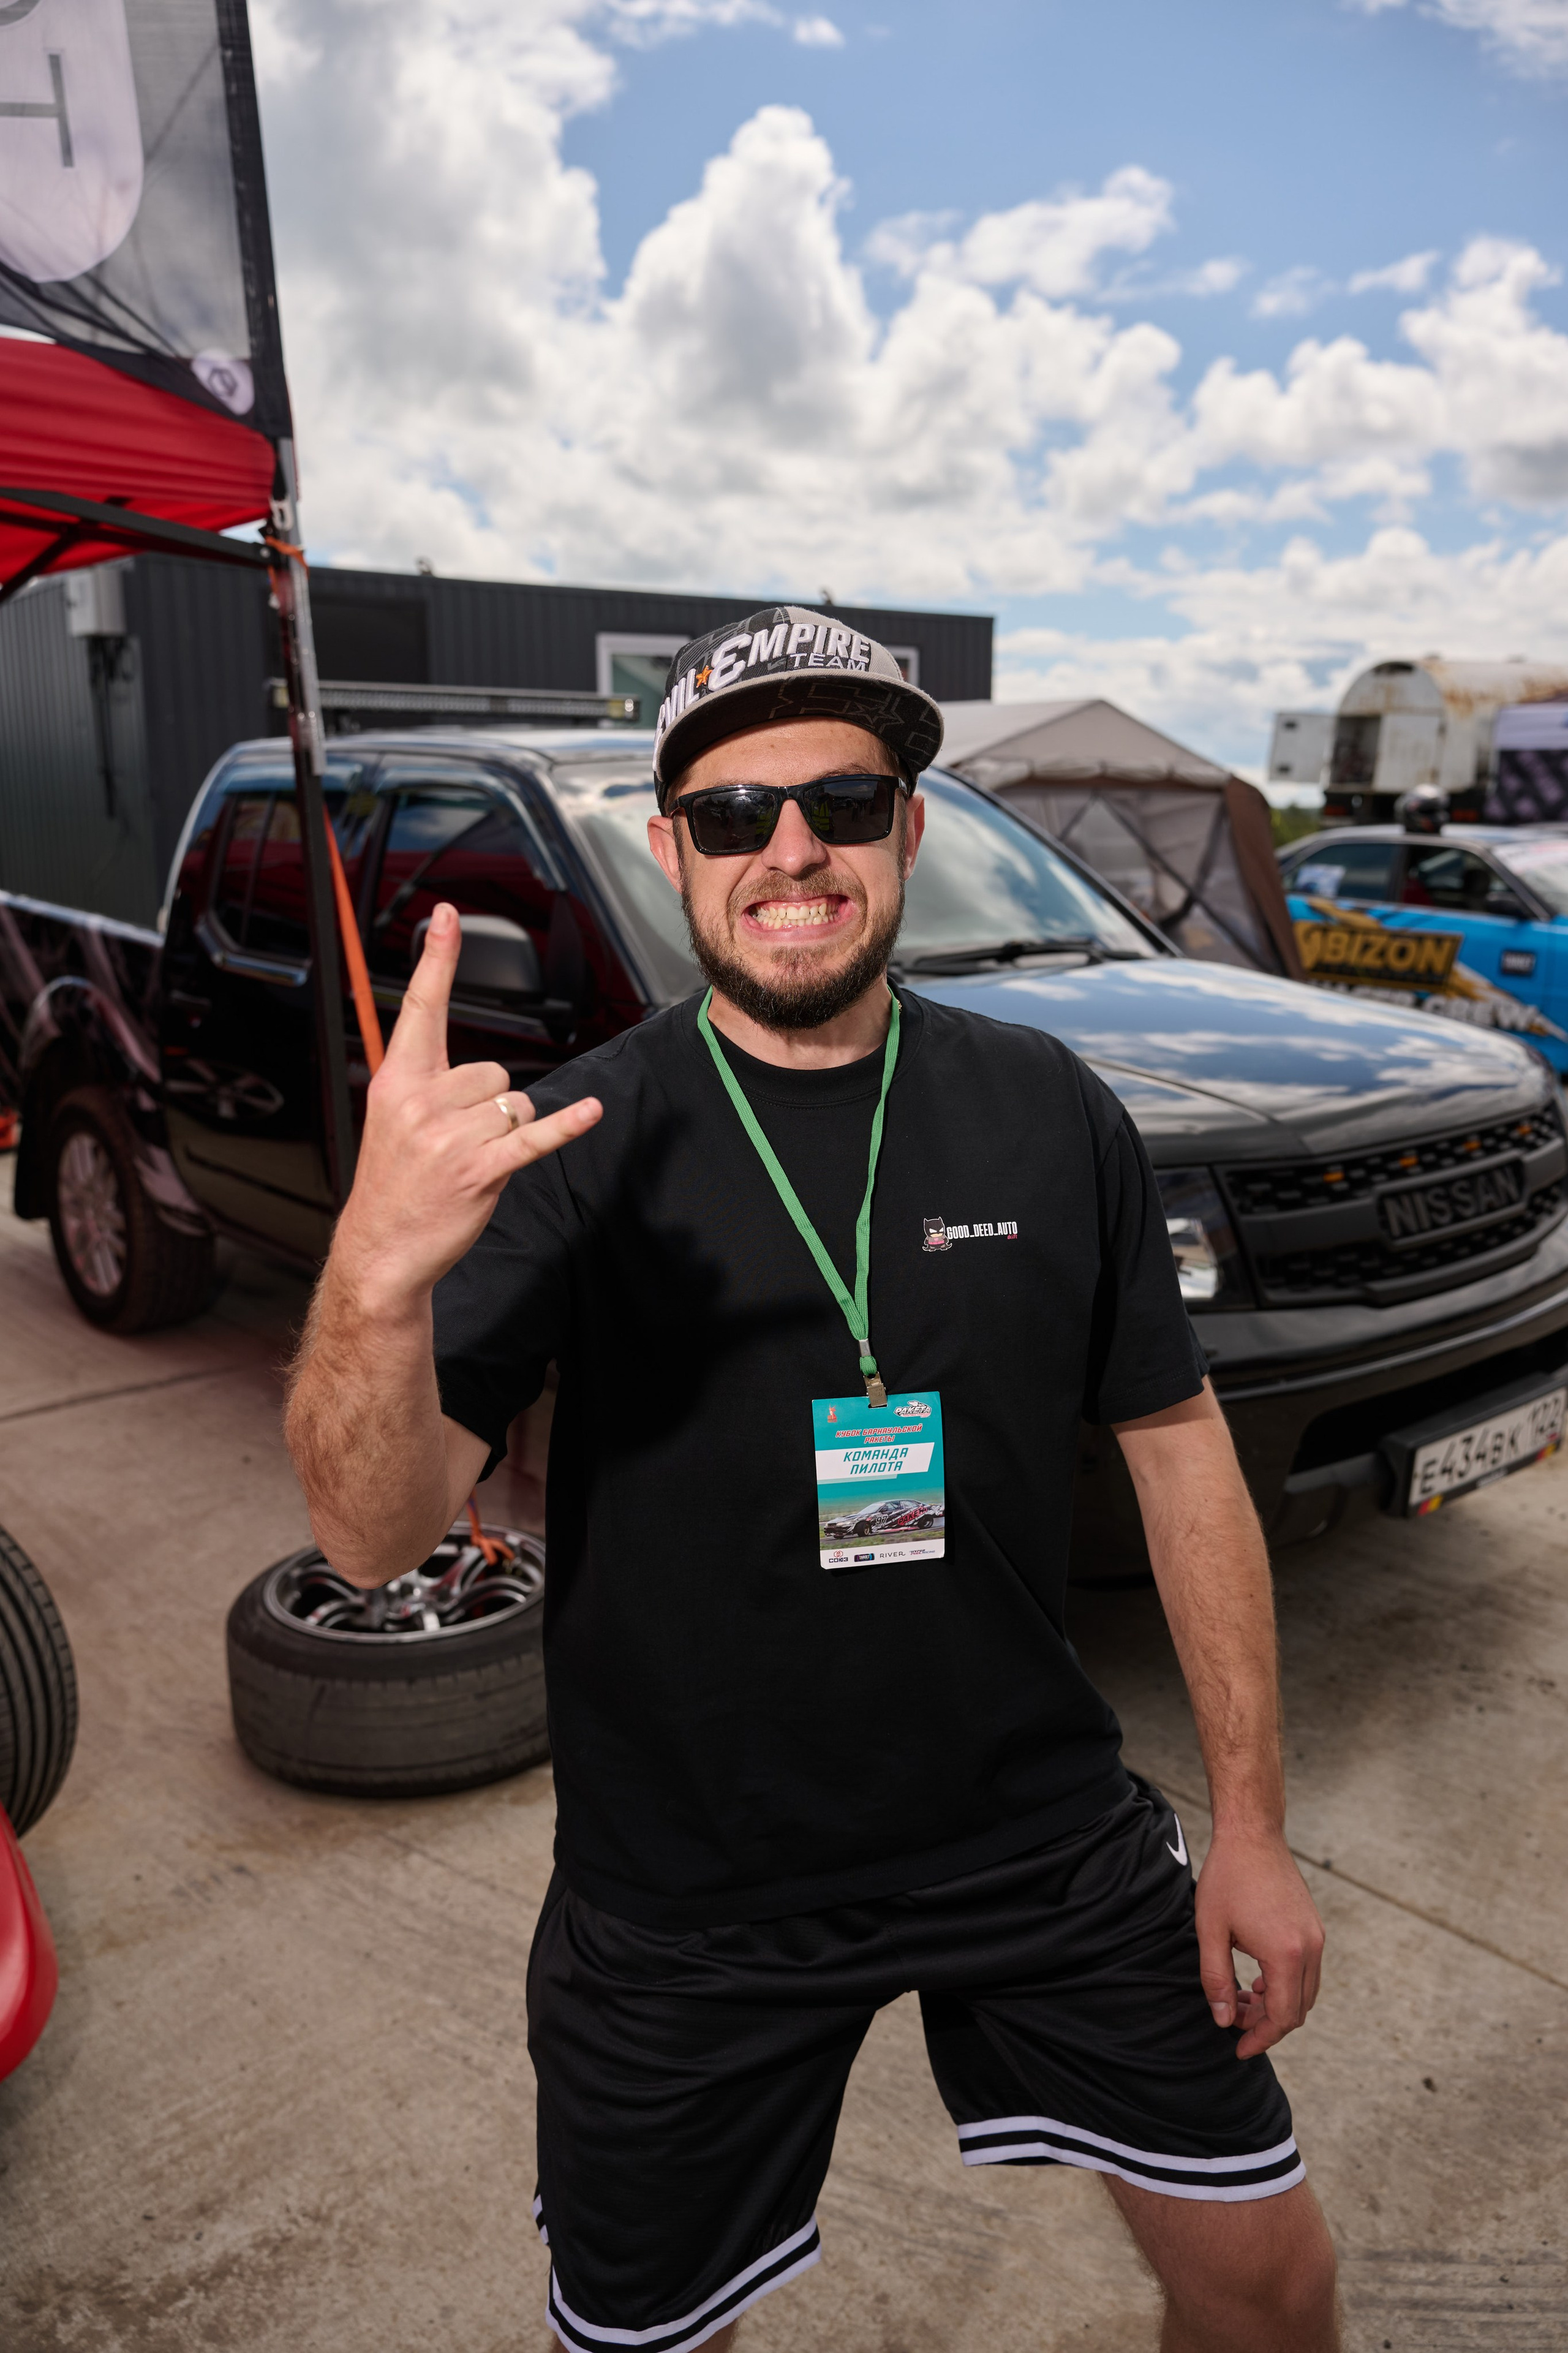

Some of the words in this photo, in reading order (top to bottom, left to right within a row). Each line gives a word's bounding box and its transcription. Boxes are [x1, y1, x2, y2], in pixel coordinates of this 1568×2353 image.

[708, 624, 871, 692] EMPIRE
[790, 652, 869, 672] TEAM
[1322, 930, 1452, 974] BIZON
[1383, 1165, 1520, 1237] NISSAN
[946, 1221, 1018, 1240] GOOD_DEED_AUTO
[895, 1406, 931, 1415] РАКЕТА
[835, 1429, 861, 1438] КУБОК
[862, 1423, 922, 1436] БАРНАУЛЬСКОЙ
[864, 1435, 895, 1444] РАКЕТЫ
[843, 1448, 909, 1462] КОМАНДА
[850, 1461, 903, 1475] ПИЛОТА
[876, 1516, 888, 1525] 97
